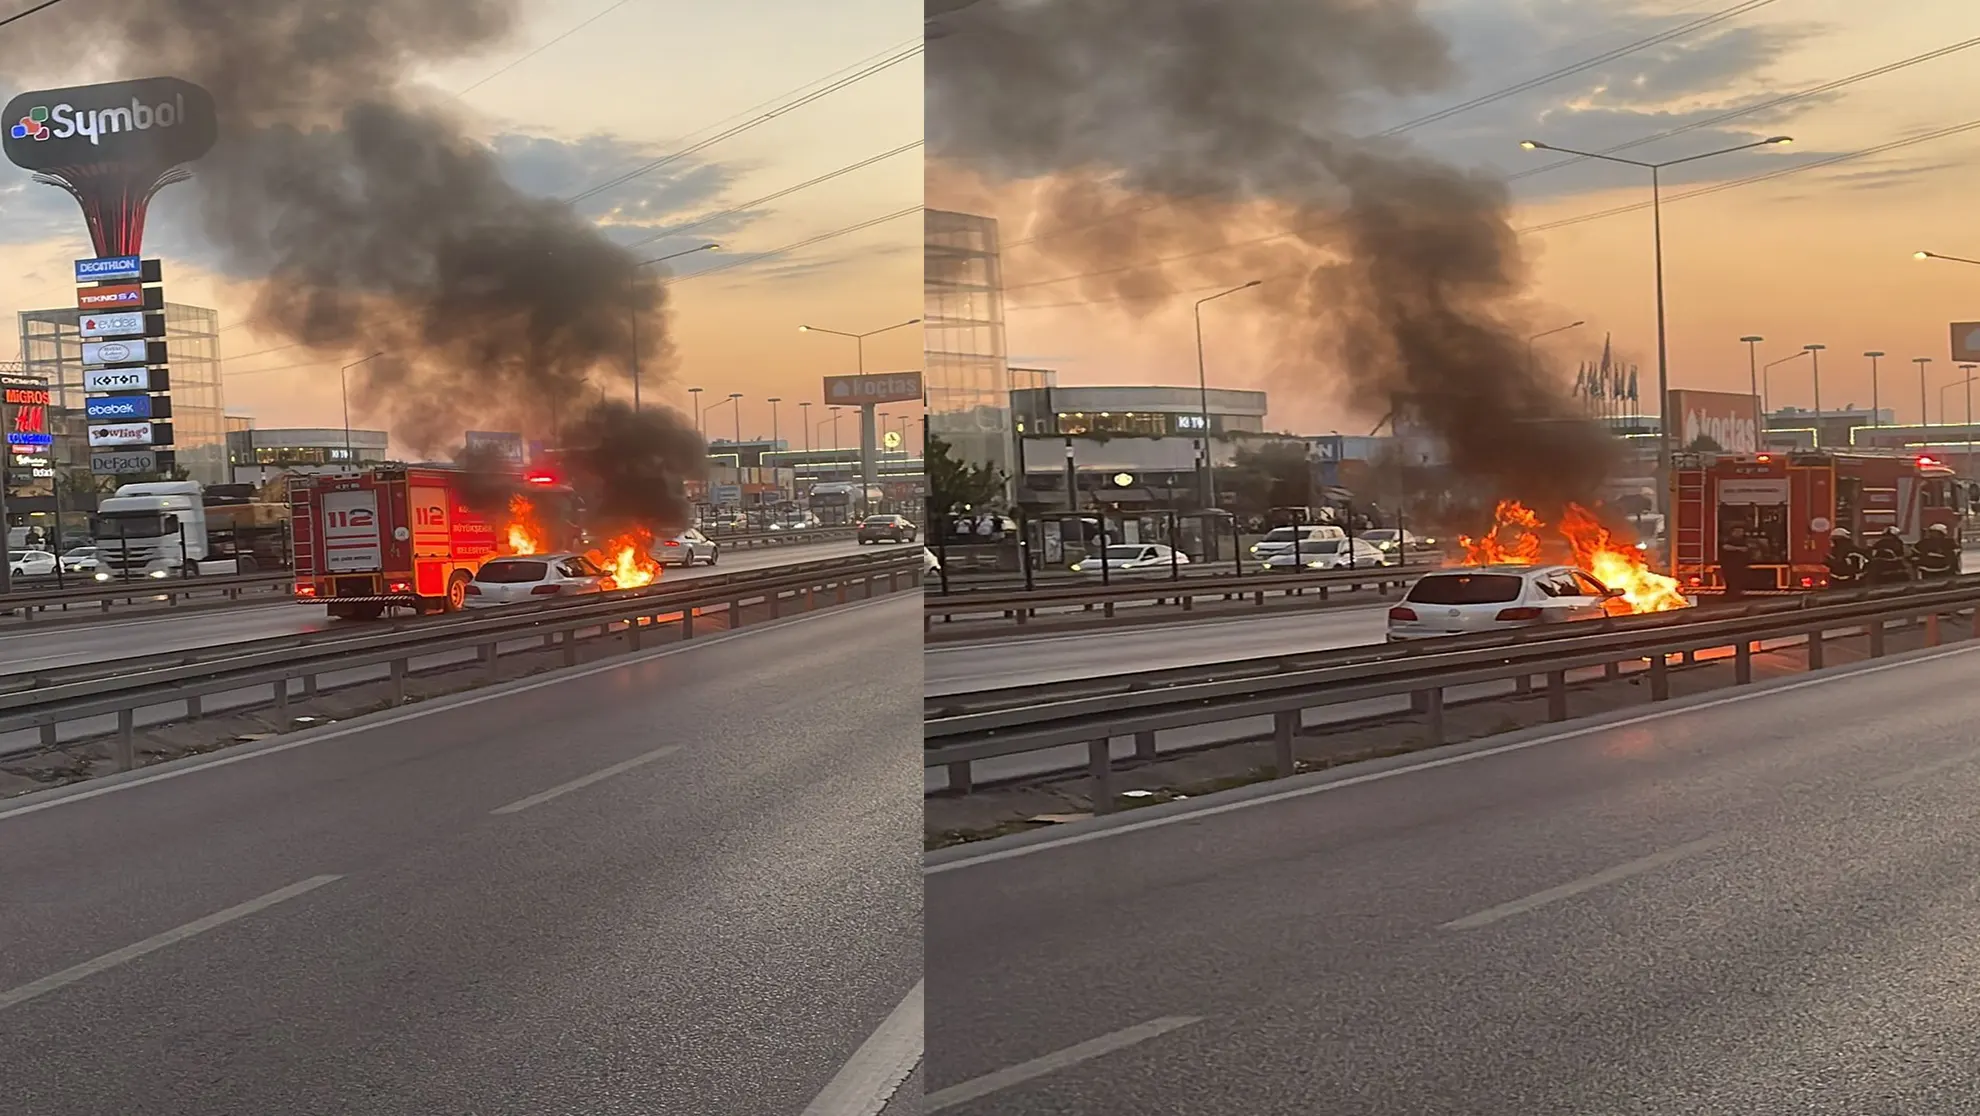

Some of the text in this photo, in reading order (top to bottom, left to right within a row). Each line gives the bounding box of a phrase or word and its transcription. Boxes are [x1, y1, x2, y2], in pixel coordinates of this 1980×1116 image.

[51, 93, 184, 145] Symbol
[80, 260, 135, 272] DECATHLON
[98, 317, 137, 329] evidea
[88, 404, 134, 415] ebebek
[93, 457, 151, 472] DeFacto
[328, 508, 374, 528] 112
[416, 506, 444, 525] 112
